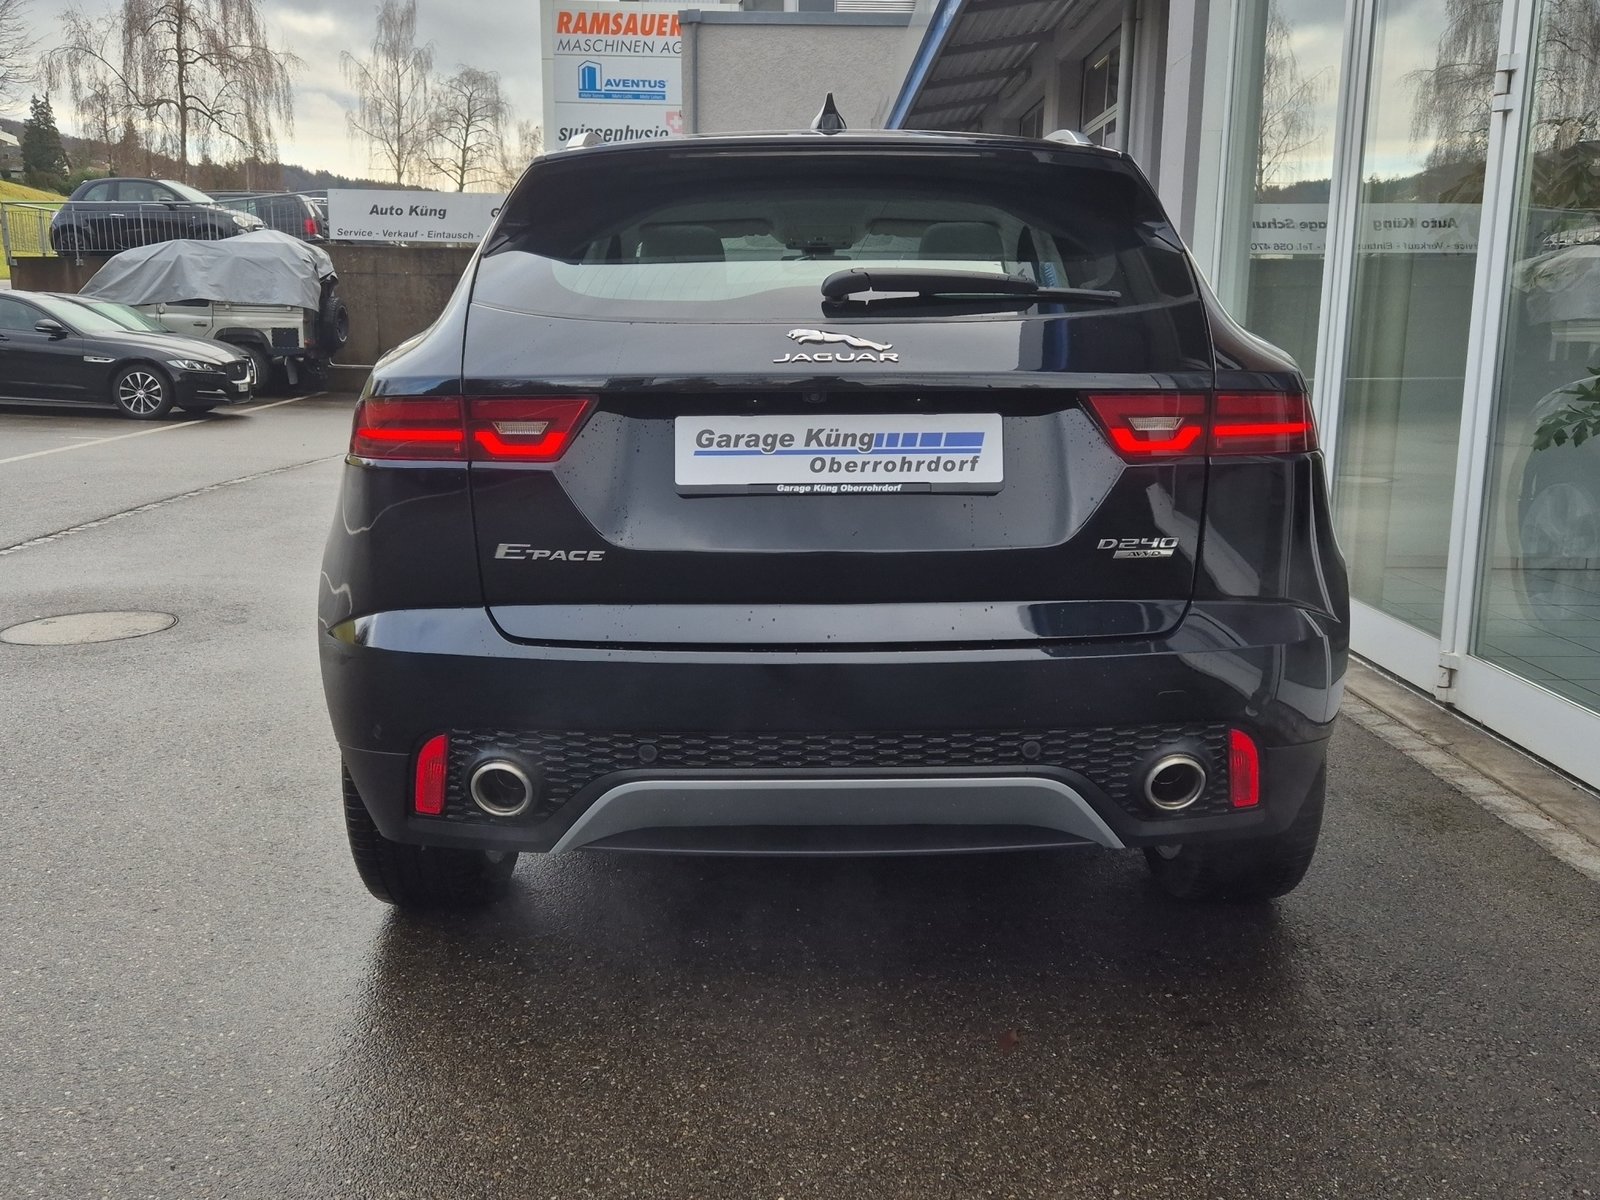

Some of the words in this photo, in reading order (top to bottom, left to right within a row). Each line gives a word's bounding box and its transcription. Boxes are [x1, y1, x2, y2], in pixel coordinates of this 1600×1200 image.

[557, 11, 682, 37] RAMSAUER
[557, 38, 655, 54] MASCHINEN
[660, 42, 682, 54] AG
[604, 79, 666, 89] AVENTUS
[369, 204, 404, 216] Auto
[408, 205, 447, 219] Küng
[337, 228, 373, 237] Service
[382, 229, 419, 238] Verkauf
[427, 230, 474, 239] Eintausch
[773, 352, 900, 364] JAGUAR
[695, 428, 795, 453] Garage
[804, 428, 875, 453] Küng
[809, 455, 980, 473] Oberrohrdorf
[776, 484, 811, 494] Garage
[813, 484, 838, 494] Küng
[840, 484, 903, 492] Oberrohrdorf
[1097, 537, 1180, 550] D240
